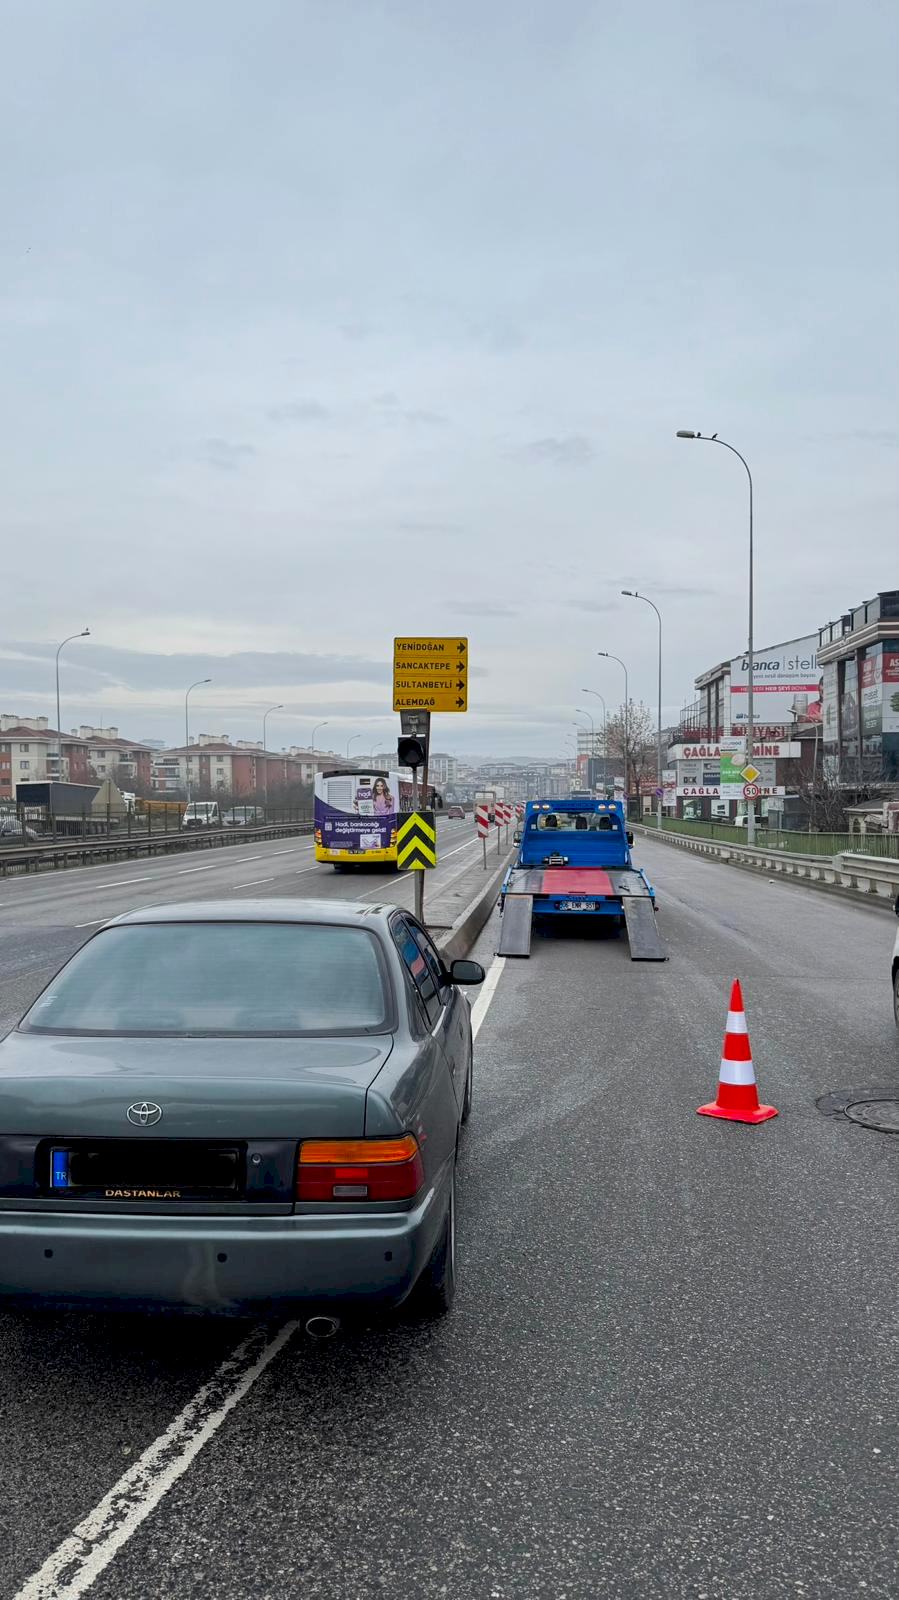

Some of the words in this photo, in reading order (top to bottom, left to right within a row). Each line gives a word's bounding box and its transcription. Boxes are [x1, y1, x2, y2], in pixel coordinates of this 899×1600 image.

[397, 642, 445, 651] YENİDOĞAN
[396, 662, 451, 670] SANCAKTEPE
[741, 659, 780, 671] banca
[395, 680, 452, 689] SULTANBEYLİ
[395, 697, 435, 706] ALEMDAĞ
[752, 743, 780, 756] MİNE
[746, 787, 756, 795] 50
[56, 1171, 67, 1180] TR
[105, 1189, 182, 1198] DASTANLAR
